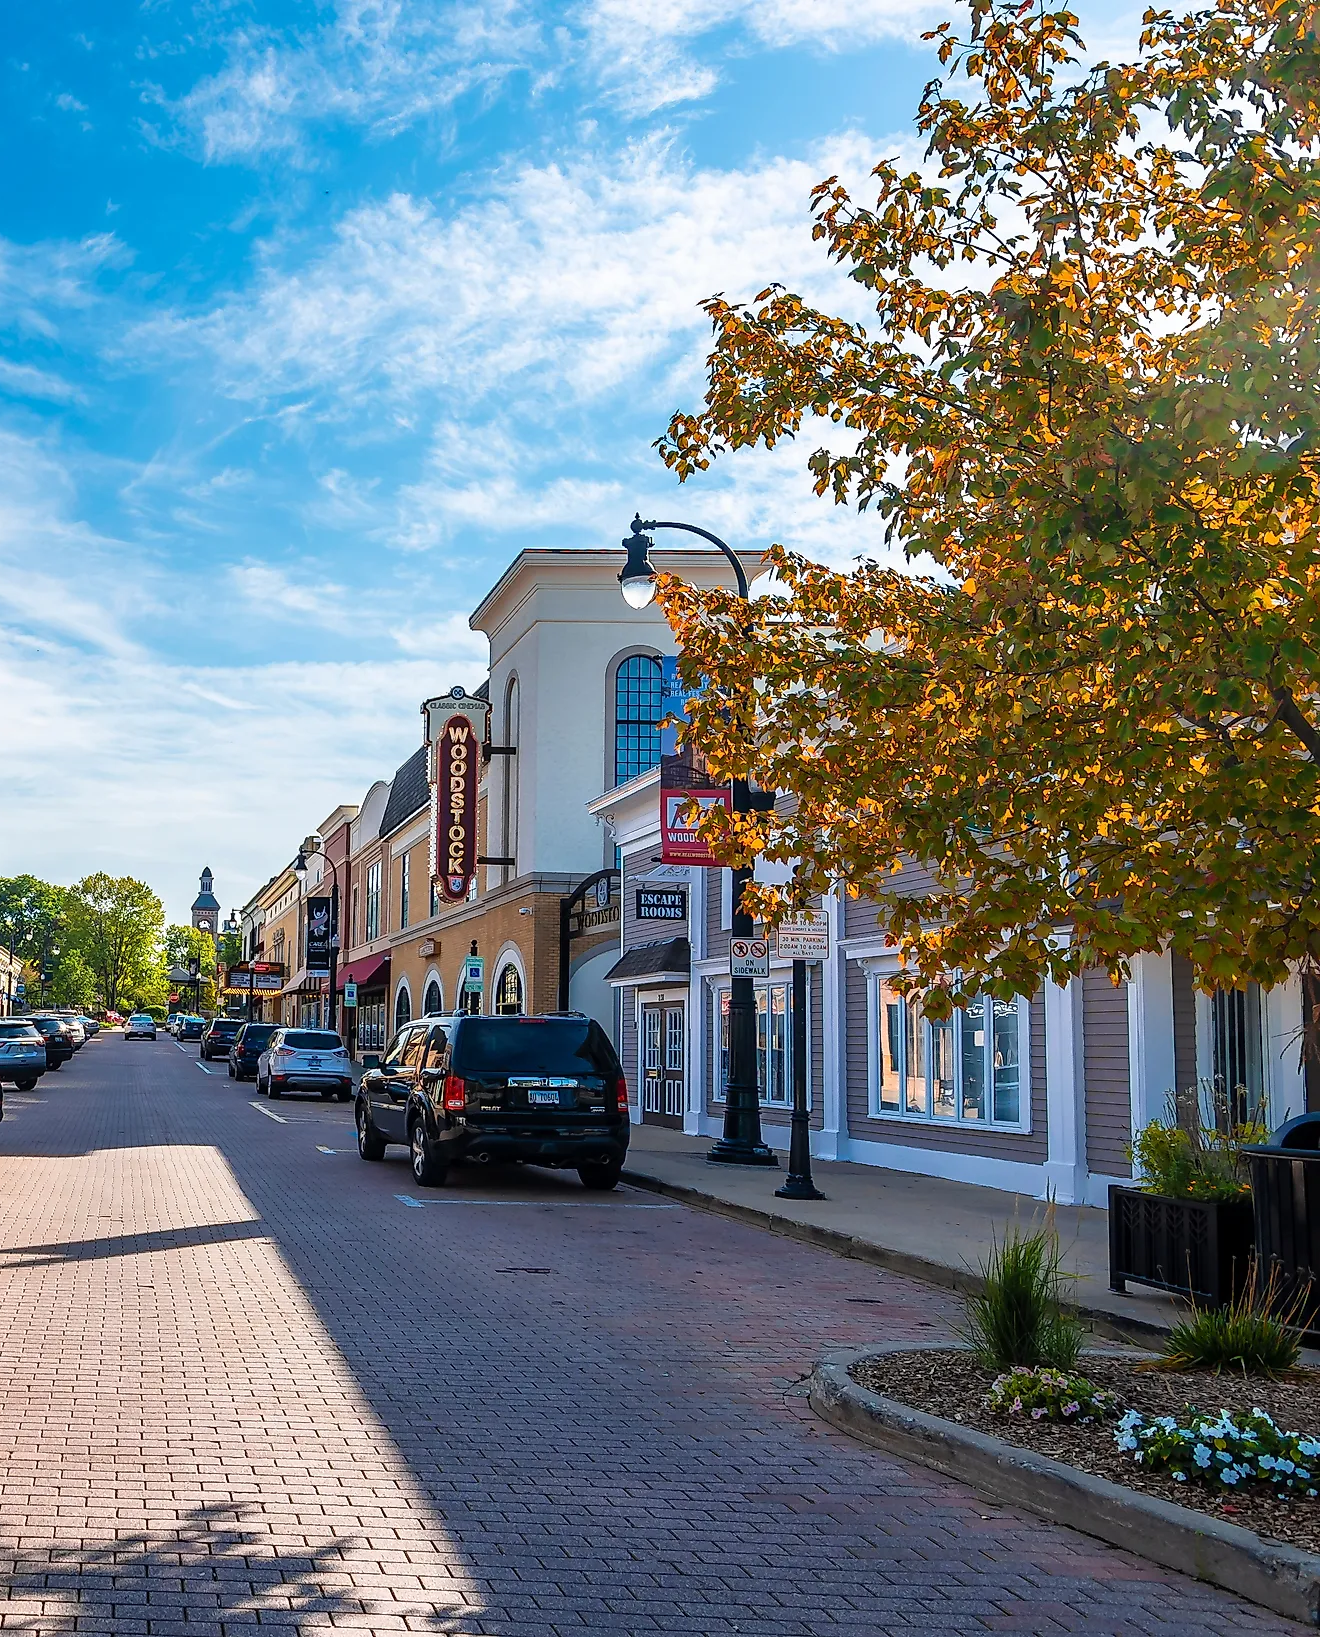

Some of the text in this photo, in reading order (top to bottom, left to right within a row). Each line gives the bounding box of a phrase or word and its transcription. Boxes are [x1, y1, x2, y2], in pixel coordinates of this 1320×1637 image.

[447, 726, 469, 874] WOODSTOCK
[641, 893, 682, 906] ESCAPE
[575, 906, 620, 930] WOODSTO
[641, 906, 683, 918] ROOMS
[734, 966, 766, 975] SIDEWALK
